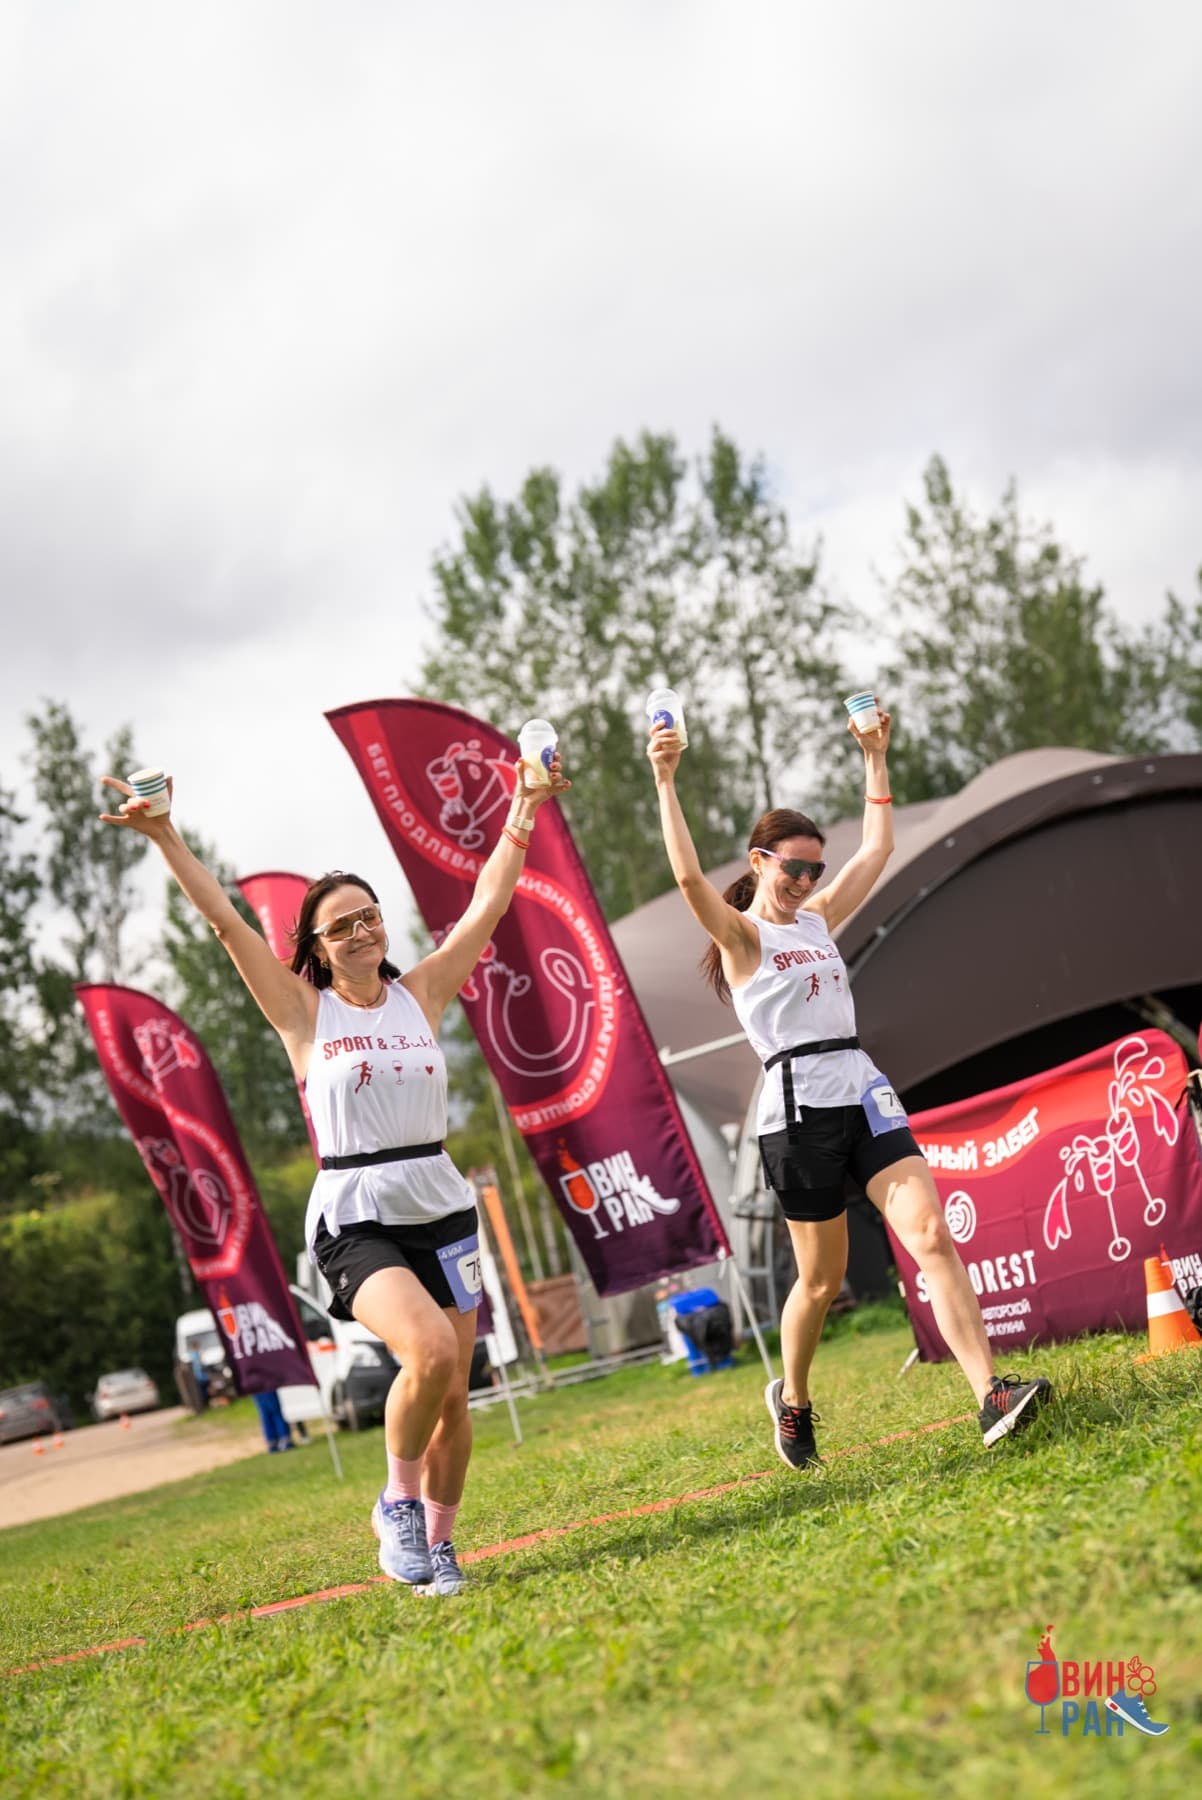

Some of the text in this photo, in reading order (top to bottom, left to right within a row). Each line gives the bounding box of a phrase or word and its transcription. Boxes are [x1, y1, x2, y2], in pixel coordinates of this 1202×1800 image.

[367, 743, 392, 780] БЕГ
[596, 975, 615, 1059] ДЕЛАЕТ
[773, 950, 816, 971] SPORT
[814, 950, 827, 960] &
[323, 1035, 374, 1060] SPORT
[376, 1037, 388, 1050] &
[982, 1106, 1040, 1167] ЗАБЕГ
[587, 1150, 641, 1199] ВИН
